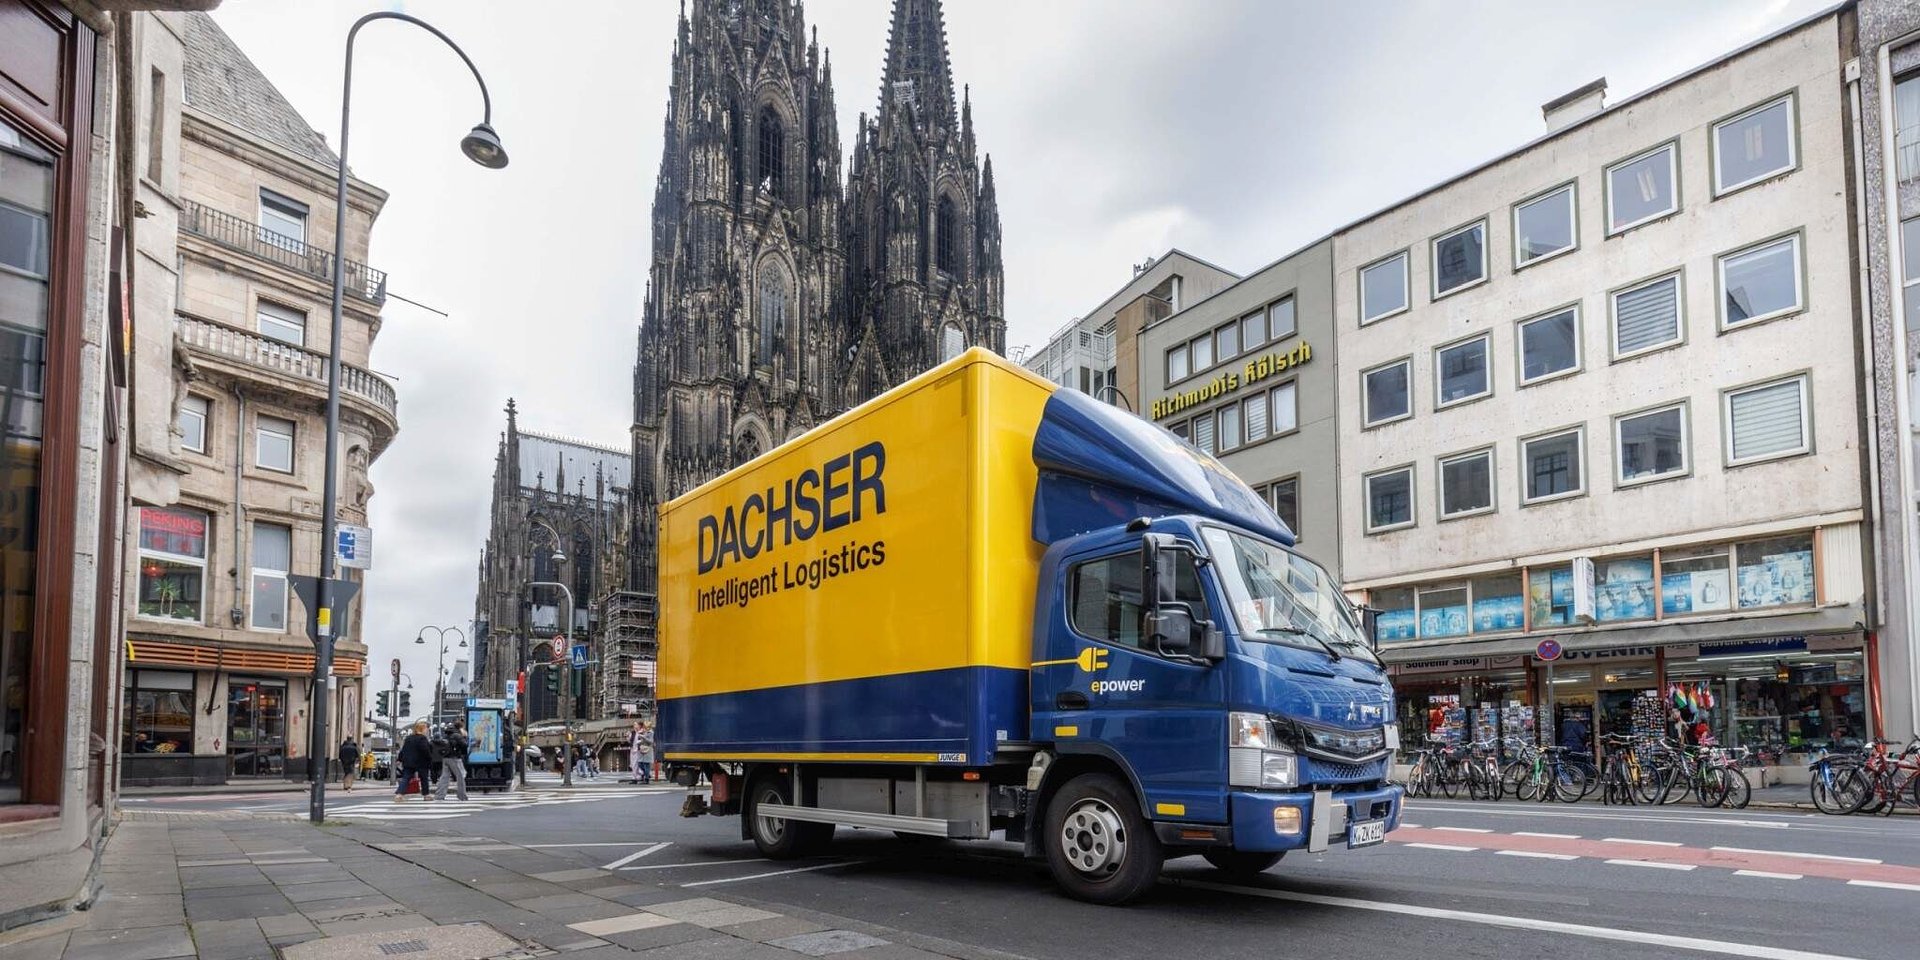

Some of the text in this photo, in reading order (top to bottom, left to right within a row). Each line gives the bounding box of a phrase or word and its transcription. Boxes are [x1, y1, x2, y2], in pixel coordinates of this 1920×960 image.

[1151, 340, 1312, 421] Richmodis Kölsch
[141, 508, 205, 535] PEKING
[698, 441, 886, 576] DACHSER
[697, 540, 886, 613] Intelligent Logistics
[1091, 679, 1146, 695] epower
